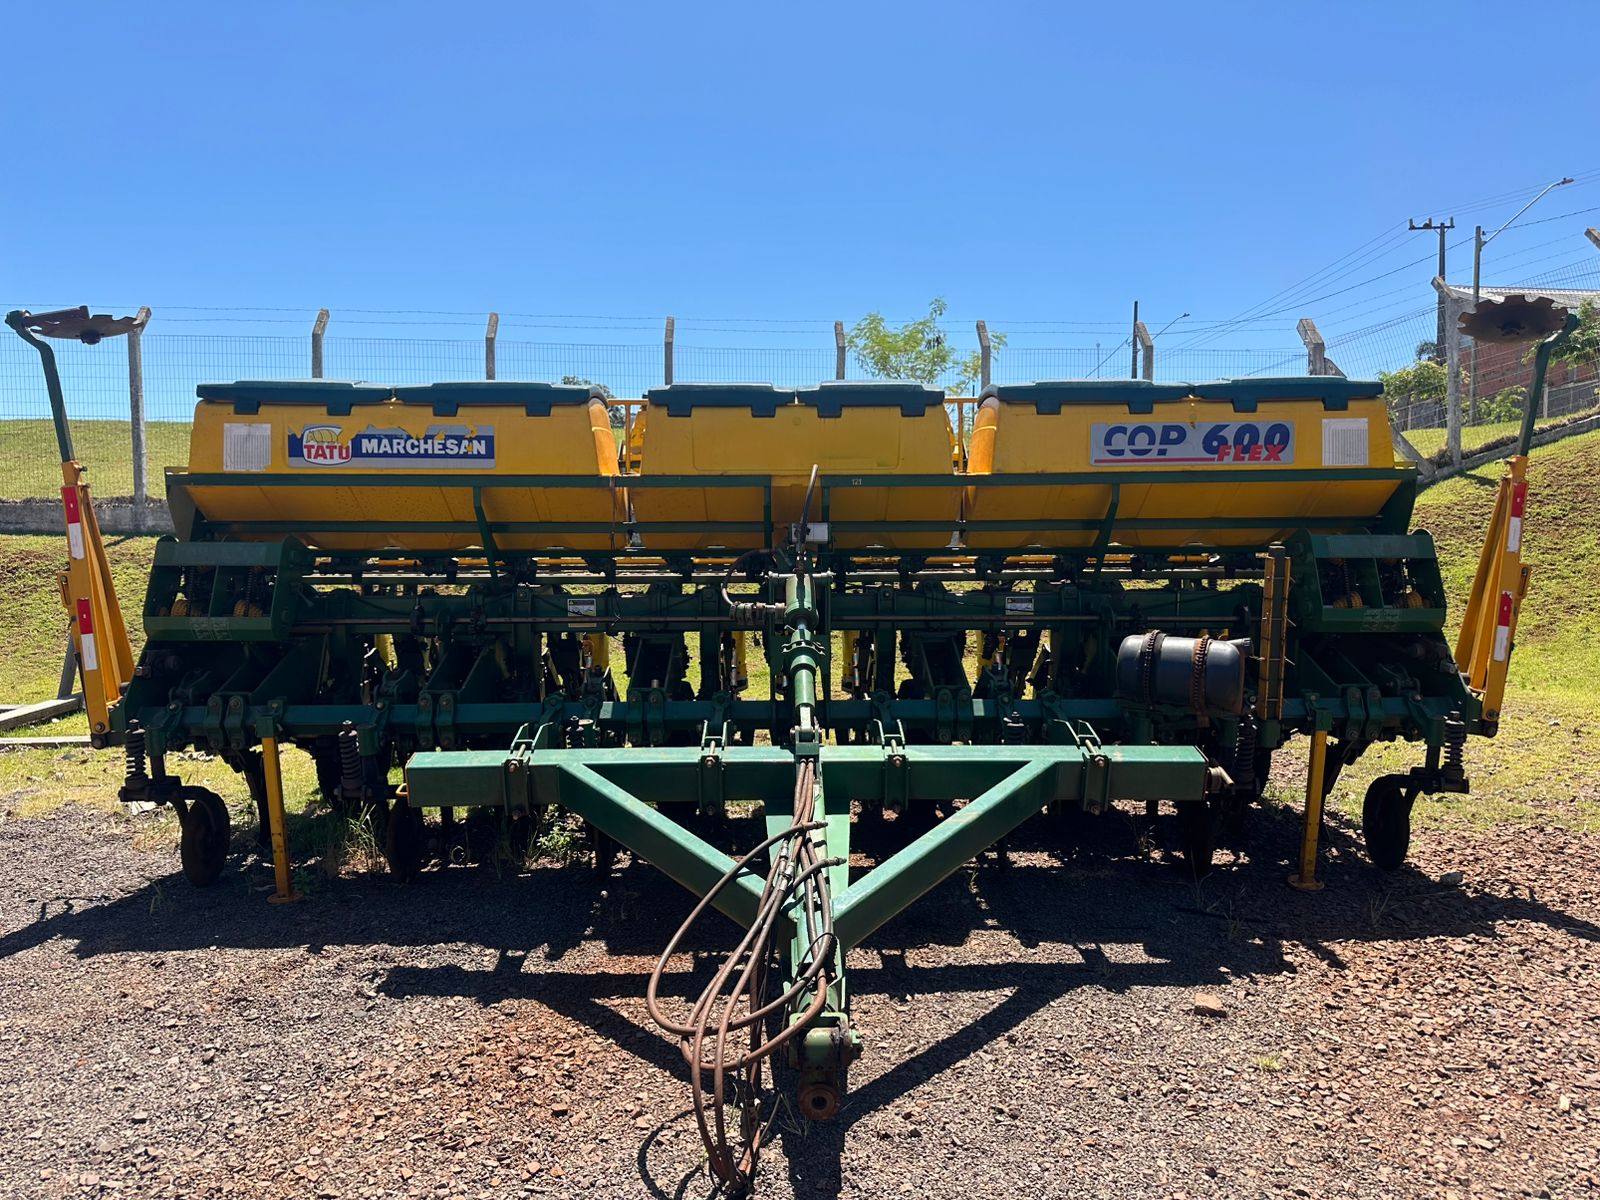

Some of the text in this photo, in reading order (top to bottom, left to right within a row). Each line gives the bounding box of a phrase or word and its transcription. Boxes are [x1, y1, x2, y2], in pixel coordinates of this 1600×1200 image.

[304, 438, 486, 460] TATU MARCHESAN
[1103, 425, 1187, 456] COP
[1202, 423, 1290, 456] 600
[1216, 444, 1285, 462] FLEX
